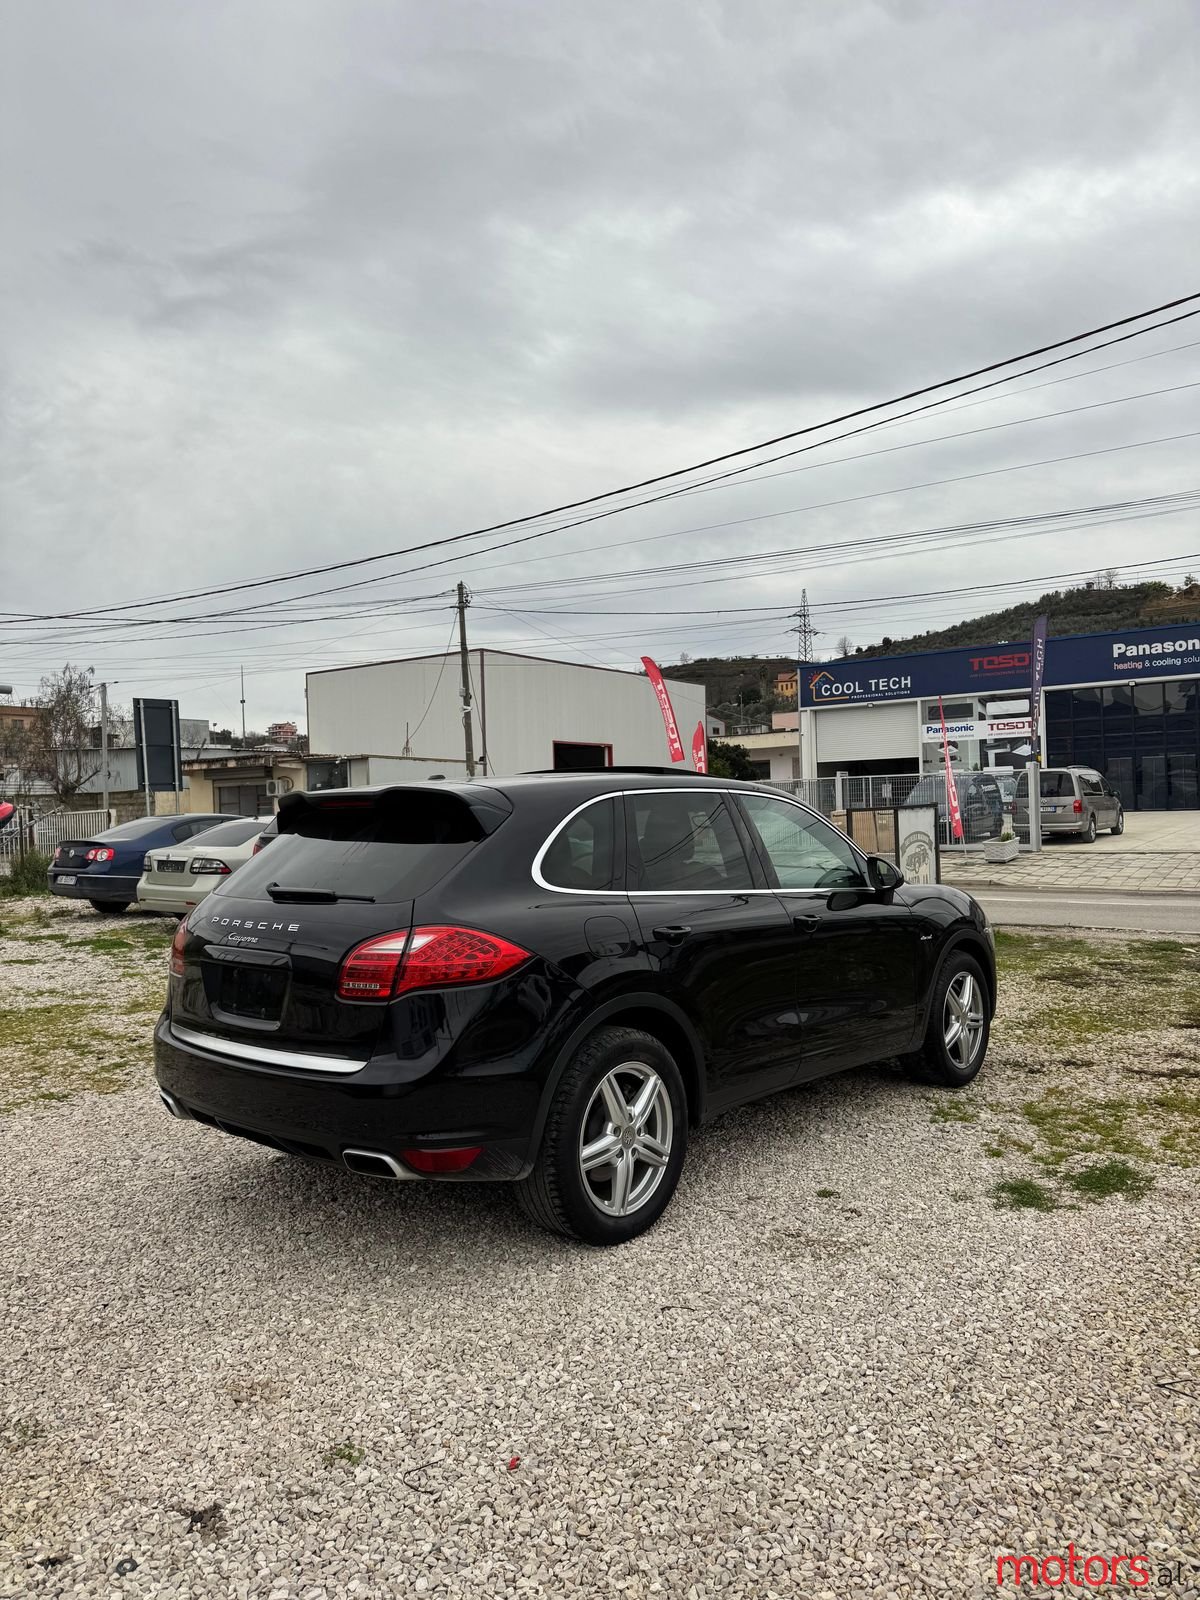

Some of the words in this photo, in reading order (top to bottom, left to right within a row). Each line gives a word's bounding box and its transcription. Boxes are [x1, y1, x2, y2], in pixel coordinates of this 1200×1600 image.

[1112, 638, 1200, 658] Panason
[969, 652, 1032, 671] TOSO
[1113, 661, 1143, 670] heating
[1152, 657, 1181, 666] cooling
[1183, 655, 1200, 664] solu
[821, 681, 864, 696] COOL
[869, 676, 911, 691] TECH
[211, 916, 300, 932] PORSCHE
[228, 932, 259, 944] Cayenne
